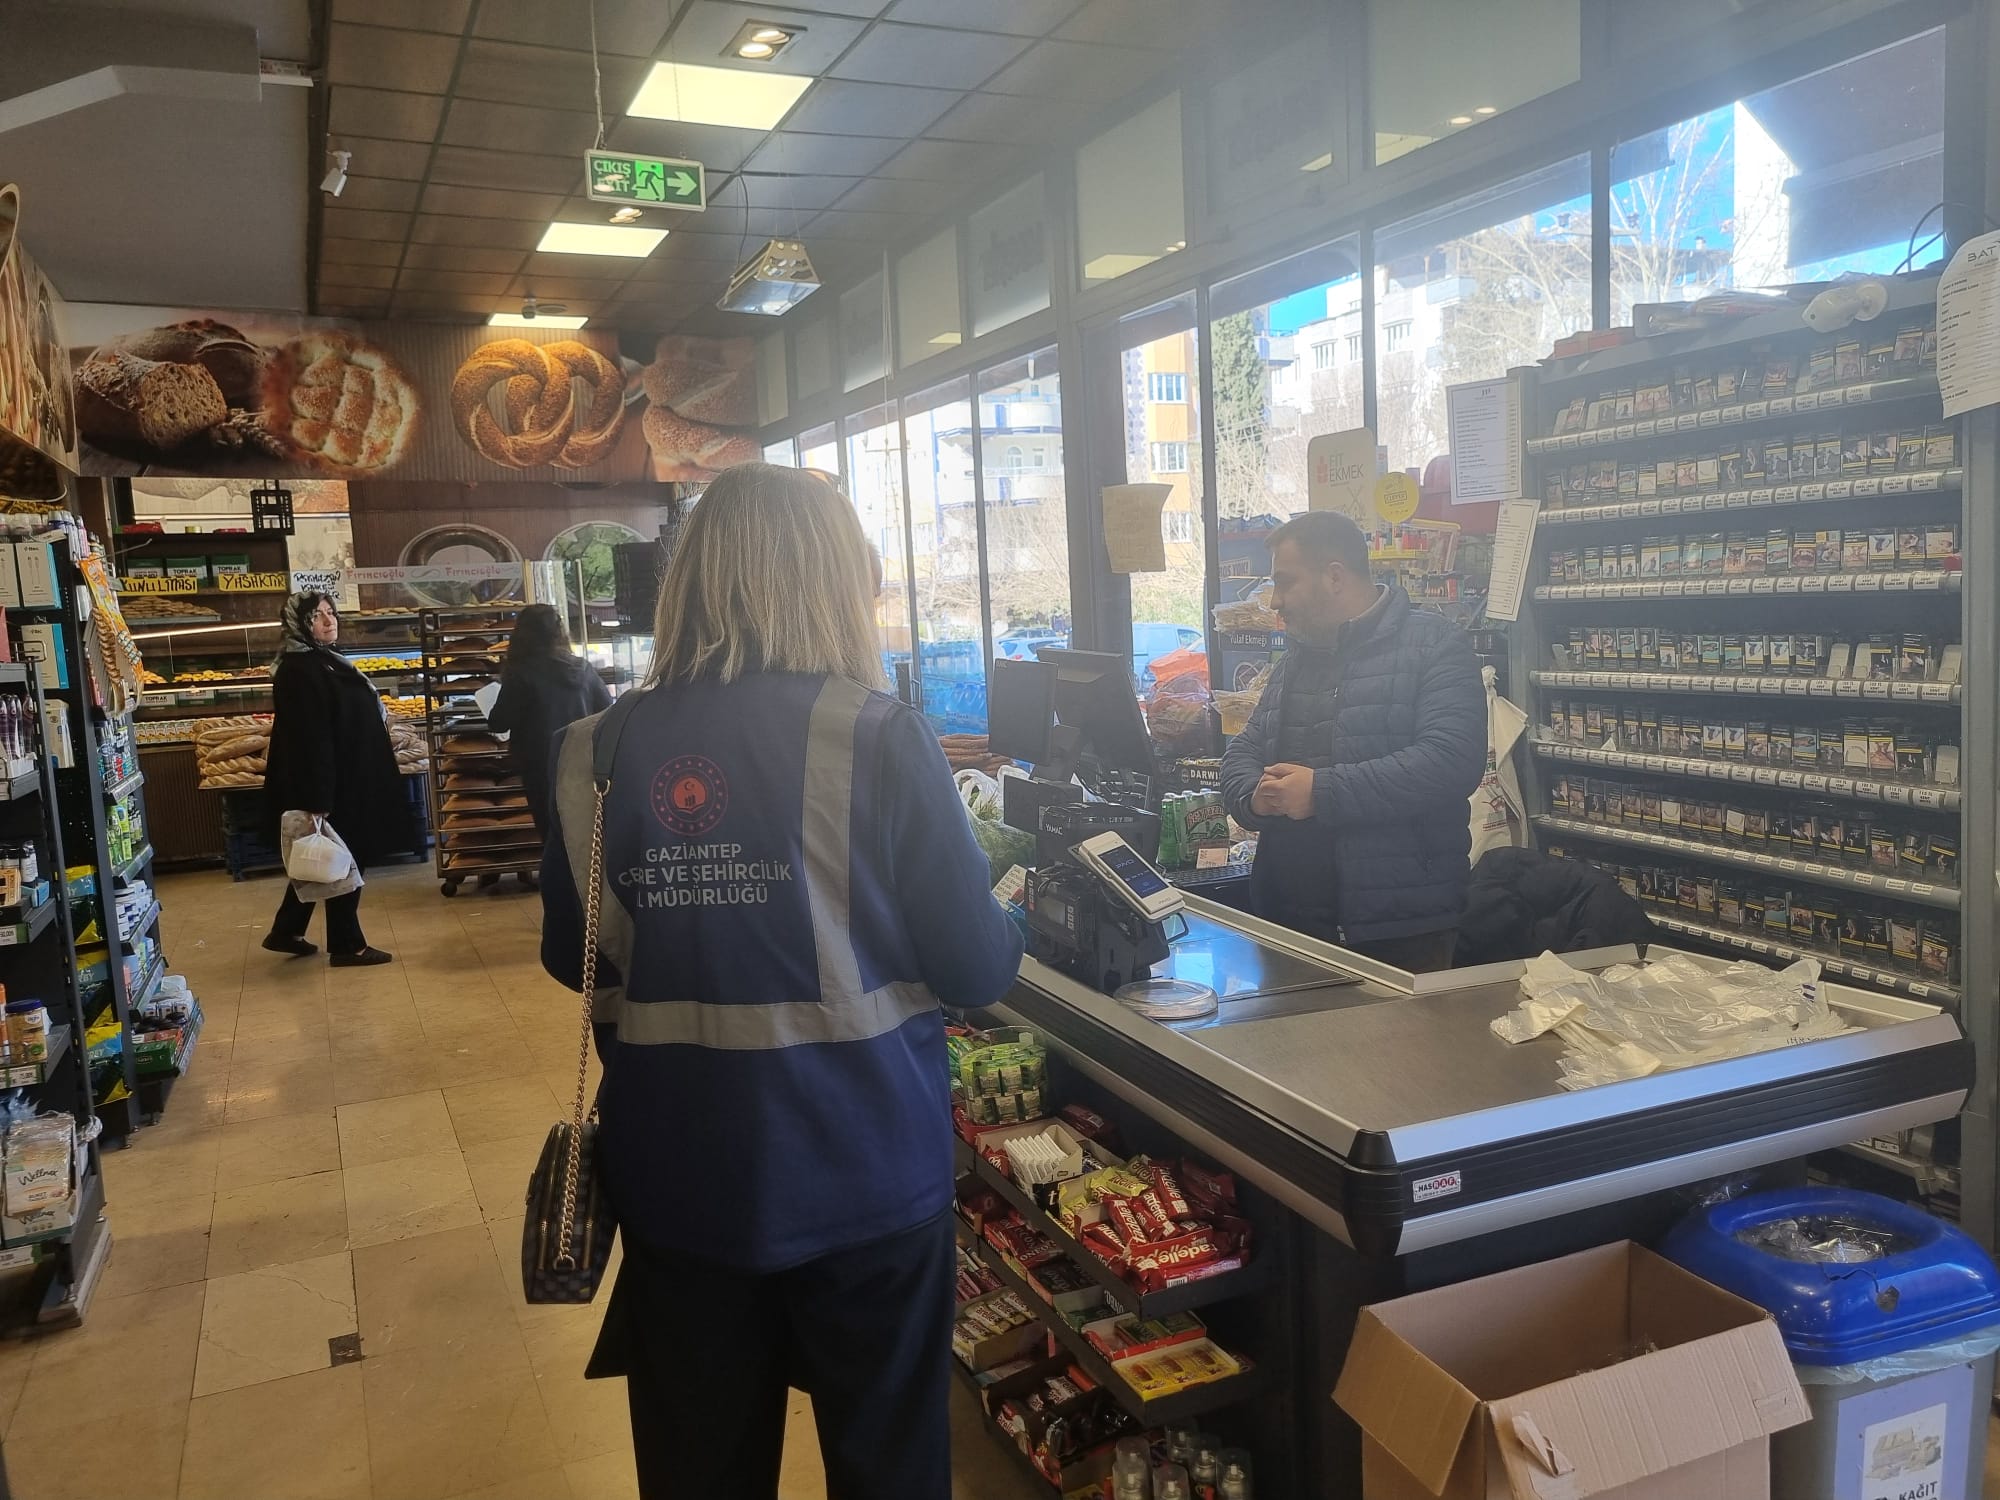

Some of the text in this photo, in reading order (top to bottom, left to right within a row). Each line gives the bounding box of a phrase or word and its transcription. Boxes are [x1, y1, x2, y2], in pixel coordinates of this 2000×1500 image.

[1330, 464, 1364, 482] EKMEK
[1190, 769, 1220, 780] DARWI
[645, 842, 742, 863] GAZİANTEP
[661, 865, 688, 883] VE
[692, 859, 792, 884] ŞEHİRCİLİK
[647, 883, 769, 908] MÜDÜRLÜĞÜ
[1899, 1481, 1938, 1500] KAĞIT
